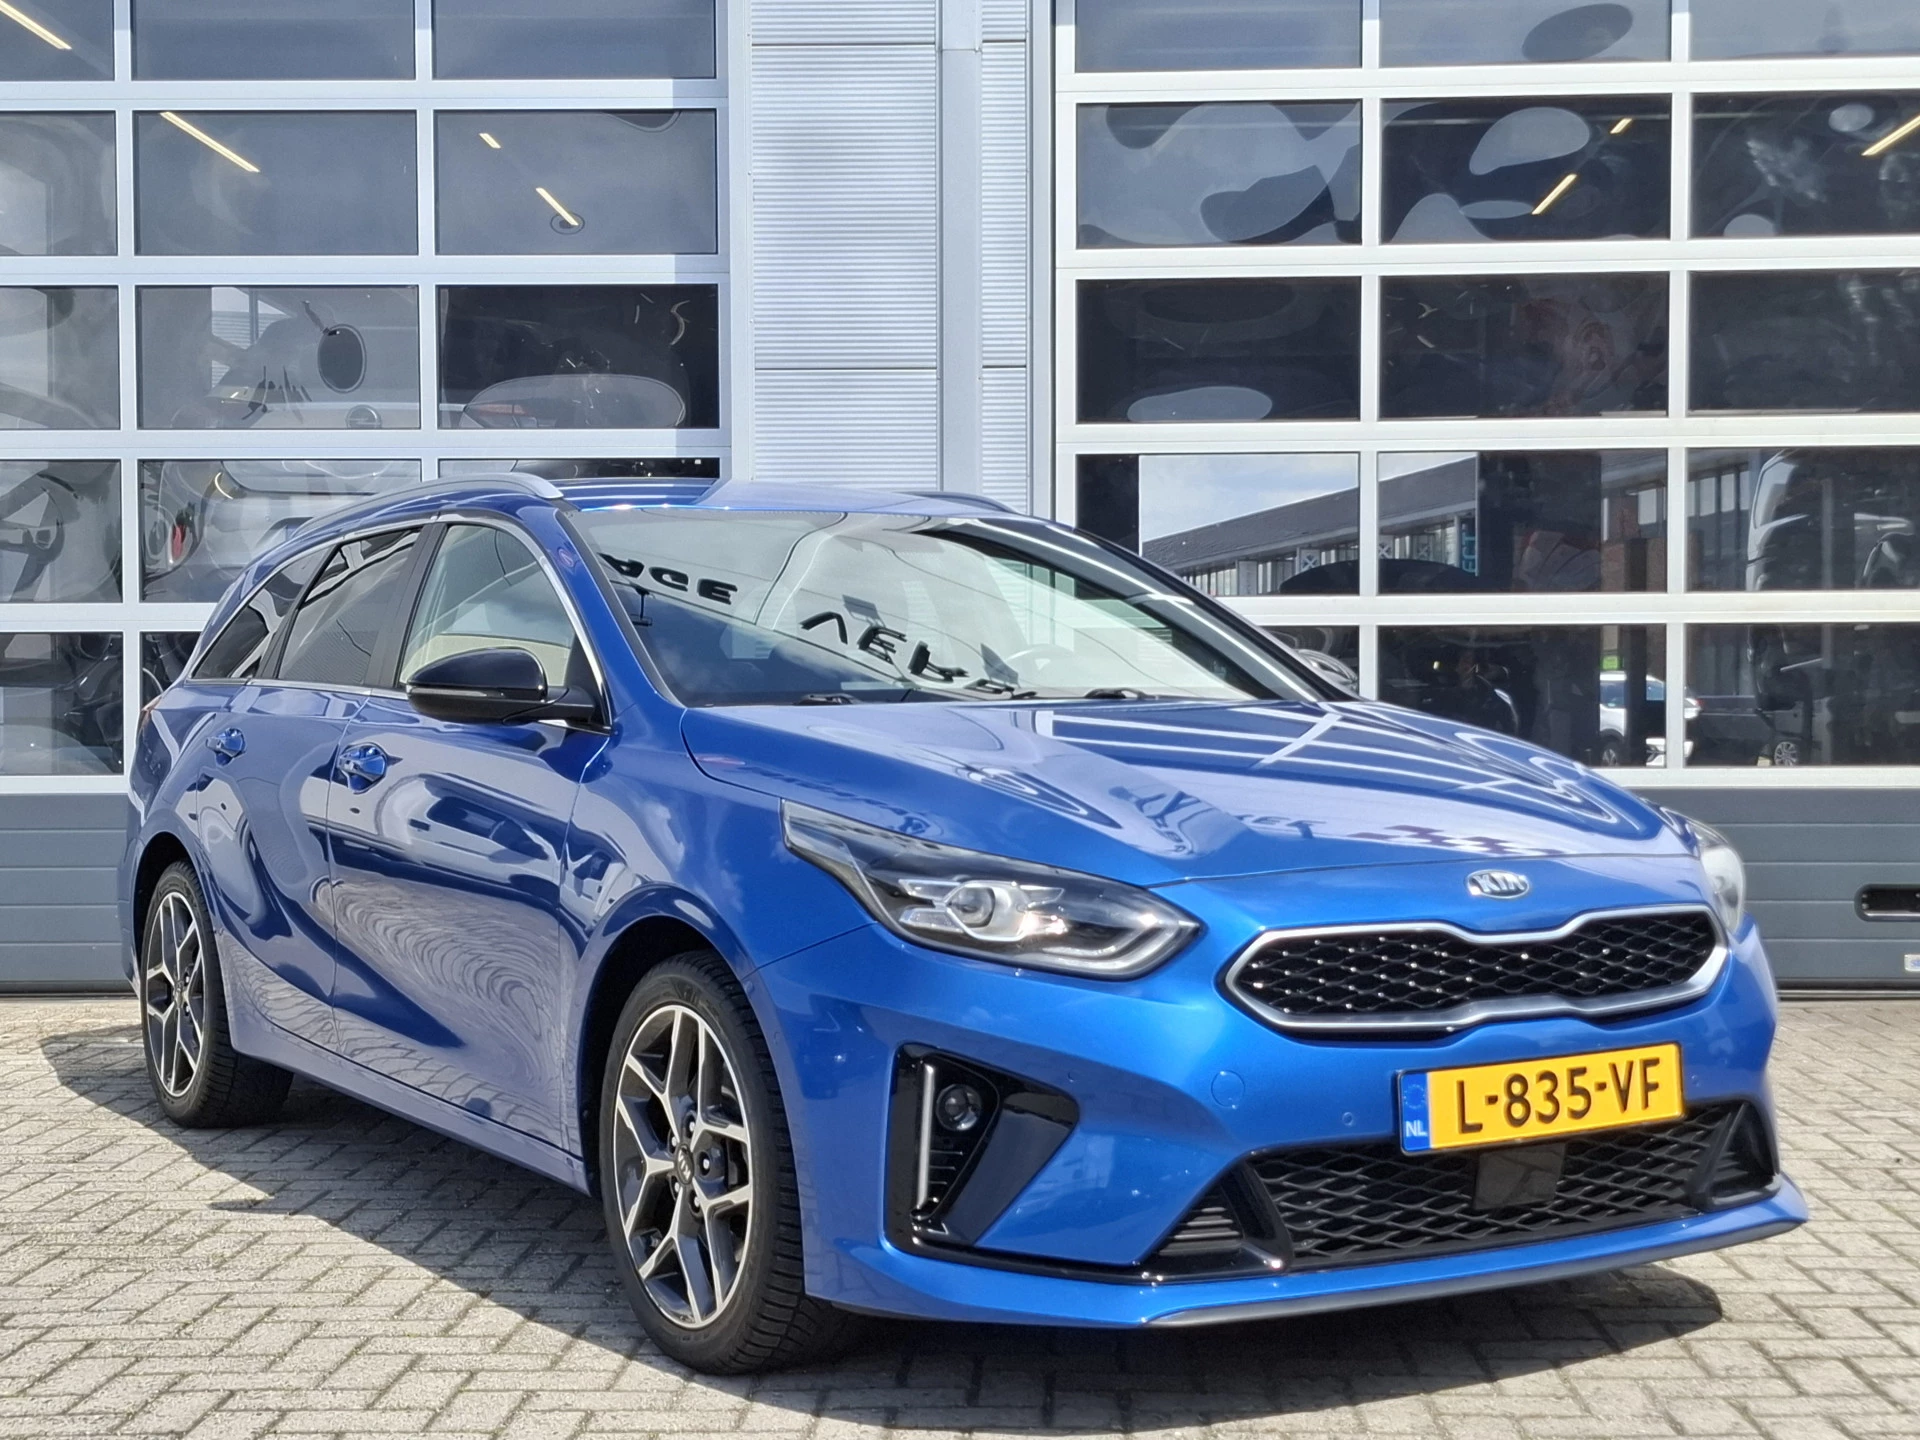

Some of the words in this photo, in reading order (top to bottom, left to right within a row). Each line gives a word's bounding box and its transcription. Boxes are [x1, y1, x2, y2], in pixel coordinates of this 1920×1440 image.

[1472, 872, 1525, 893] KIA
[1456, 1057, 1660, 1134] L-835-VF
[1405, 1119, 1428, 1138] NL
